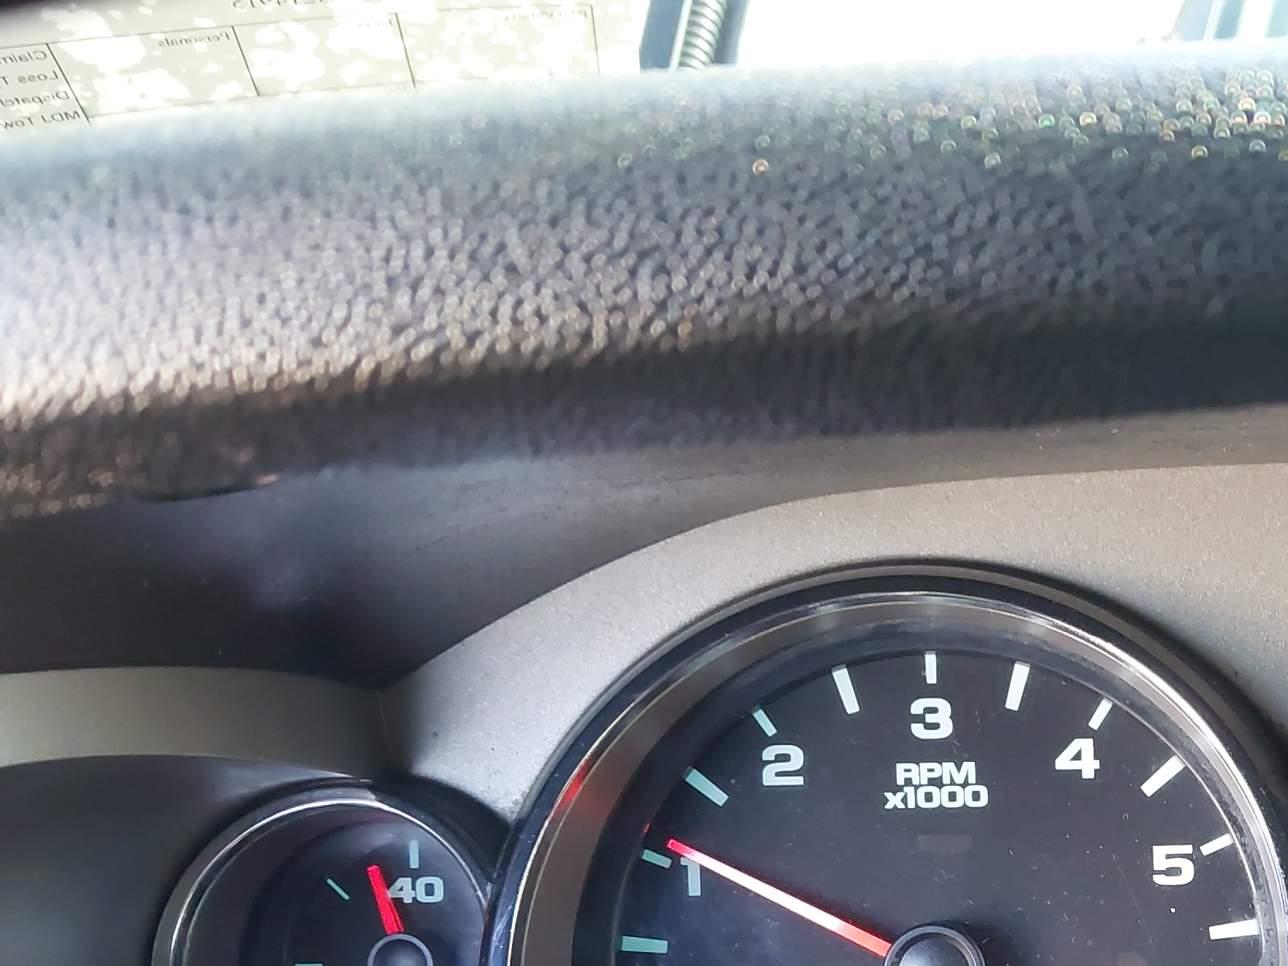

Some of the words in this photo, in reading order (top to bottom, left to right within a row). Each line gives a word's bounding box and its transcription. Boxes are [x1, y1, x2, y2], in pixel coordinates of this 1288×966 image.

[910, 697, 952, 740] 3
[761, 744, 805, 786] 2
[896, 762, 976, 785] RPM
[1055, 738, 1101, 779] 4
[884, 785, 988, 808] x1000
[1152, 844, 1194, 886] 5
[387, 876, 444, 904] 40
